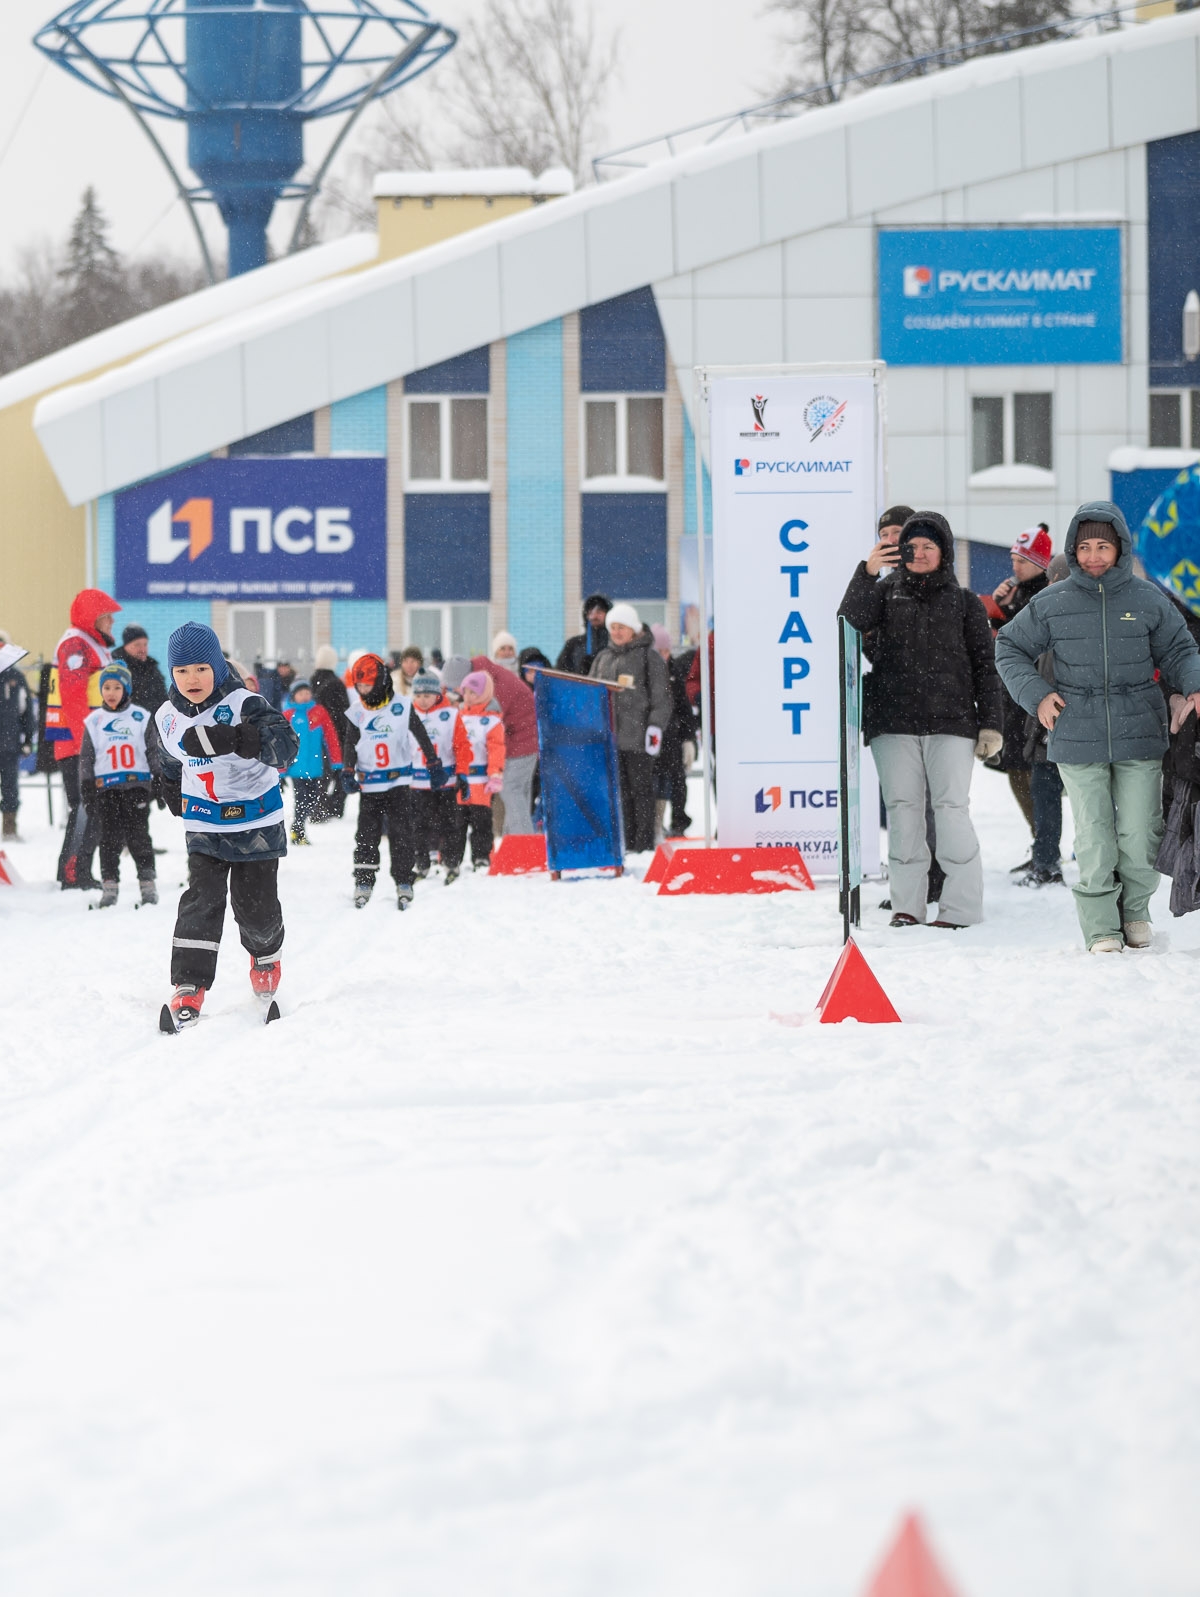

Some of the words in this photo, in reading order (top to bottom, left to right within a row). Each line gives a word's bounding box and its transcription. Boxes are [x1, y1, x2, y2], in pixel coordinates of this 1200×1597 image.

[939, 268, 1097, 292] РУСКЛИМАТ
[756, 460, 853, 474] РУСКЛИМАТ
[229, 507, 355, 555] ПСБ
[778, 519, 813, 735] СТАРТ
[106, 743, 136, 770] 10
[375, 743, 391, 769] 9
[196, 771, 219, 803] 7
